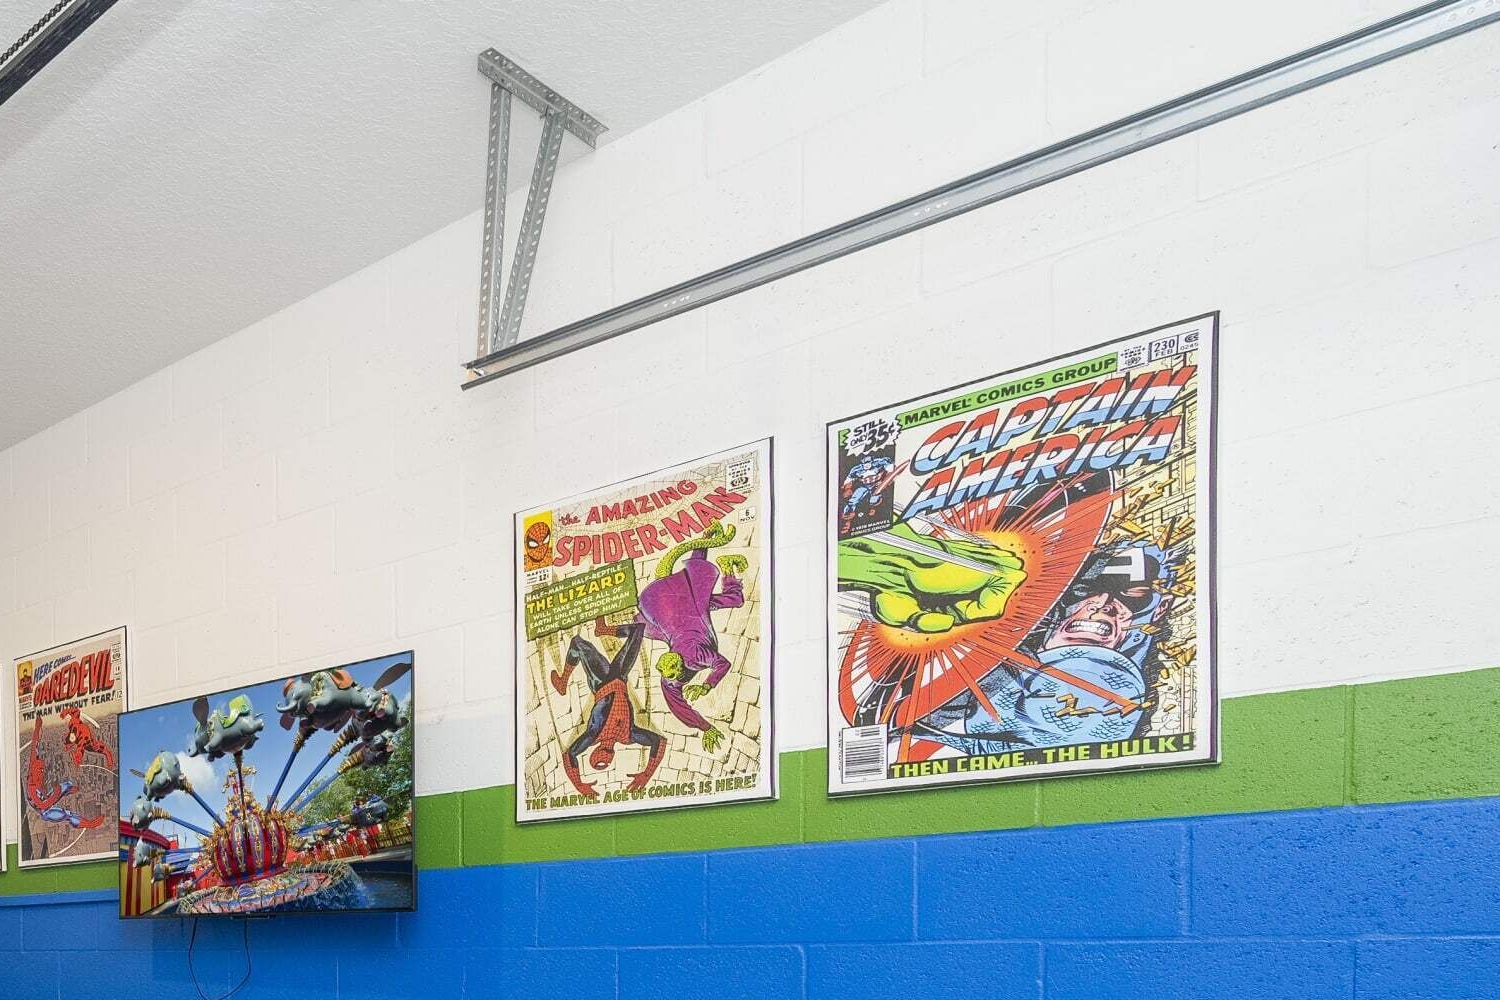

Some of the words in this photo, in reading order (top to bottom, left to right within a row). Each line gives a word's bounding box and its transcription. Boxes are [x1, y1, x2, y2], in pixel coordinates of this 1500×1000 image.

[1154, 338, 1176, 353] 230
[1155, 348, 1174, 358] FEB
[903, 398, 971, 426] MARVEL
[976, 377, 1045, 404] COMICS
[1051, 356, 1117, 384] GROUP
[853, 418, 886, 437] STILL
[910, 365, 1197, 477] CAPTAIN
[850, 432, 868, 447] ONLY
[901, 415, 1182, 521] AMERICA
[559, 512, 581, 526] the
[585, 479, 698, 526] AMAZING
[553, 486, 748, 568] SPIDER-MAN
[526, 595, 554, 614] THE
[559, 571, 626, 604] LIZARD
[530, 618, 552, 629] EARTH
[555, 607, 582, 621] UNLESS
[585, 592, 630, 611] SPIDER-MAN
[533, 611, 551, 621] WILL
[553, 604, 571, 614] TAKE
[574, 596, 593, 607] OVER
[596, 591, 611, 601] ALL
[613, 586, 623, 595] OF
[536, 622, 560, 634] ALONE
[562, 615, 577, 625] CAN
[580, 609, 600, 621] STOP
[602, 600, 622, 613] HIM!
[33, 661, 54, 686] HERE
[33, 649, 115, 708] DAREDEVIL
[23, 710, 35, 721] THE
[36, 706, 53, 717] MAN
[55, 698, 88, 714] WITHOUT
[91, 690, 115, 706] FEAR!
[890, 760, 949, 778] THEN
[1043, 745, 1091, 763] THE
[526, 799, 548, 811] THE
[549, 793, 601, 809] MARVEL
[603, 789, 630, 804] AGE
[631, 786, 647, 801] OF
[648, 780, 696, 799] COMICS
[699, 779, 711, 794] IS
[715, 774, 757, 792] HERE!
